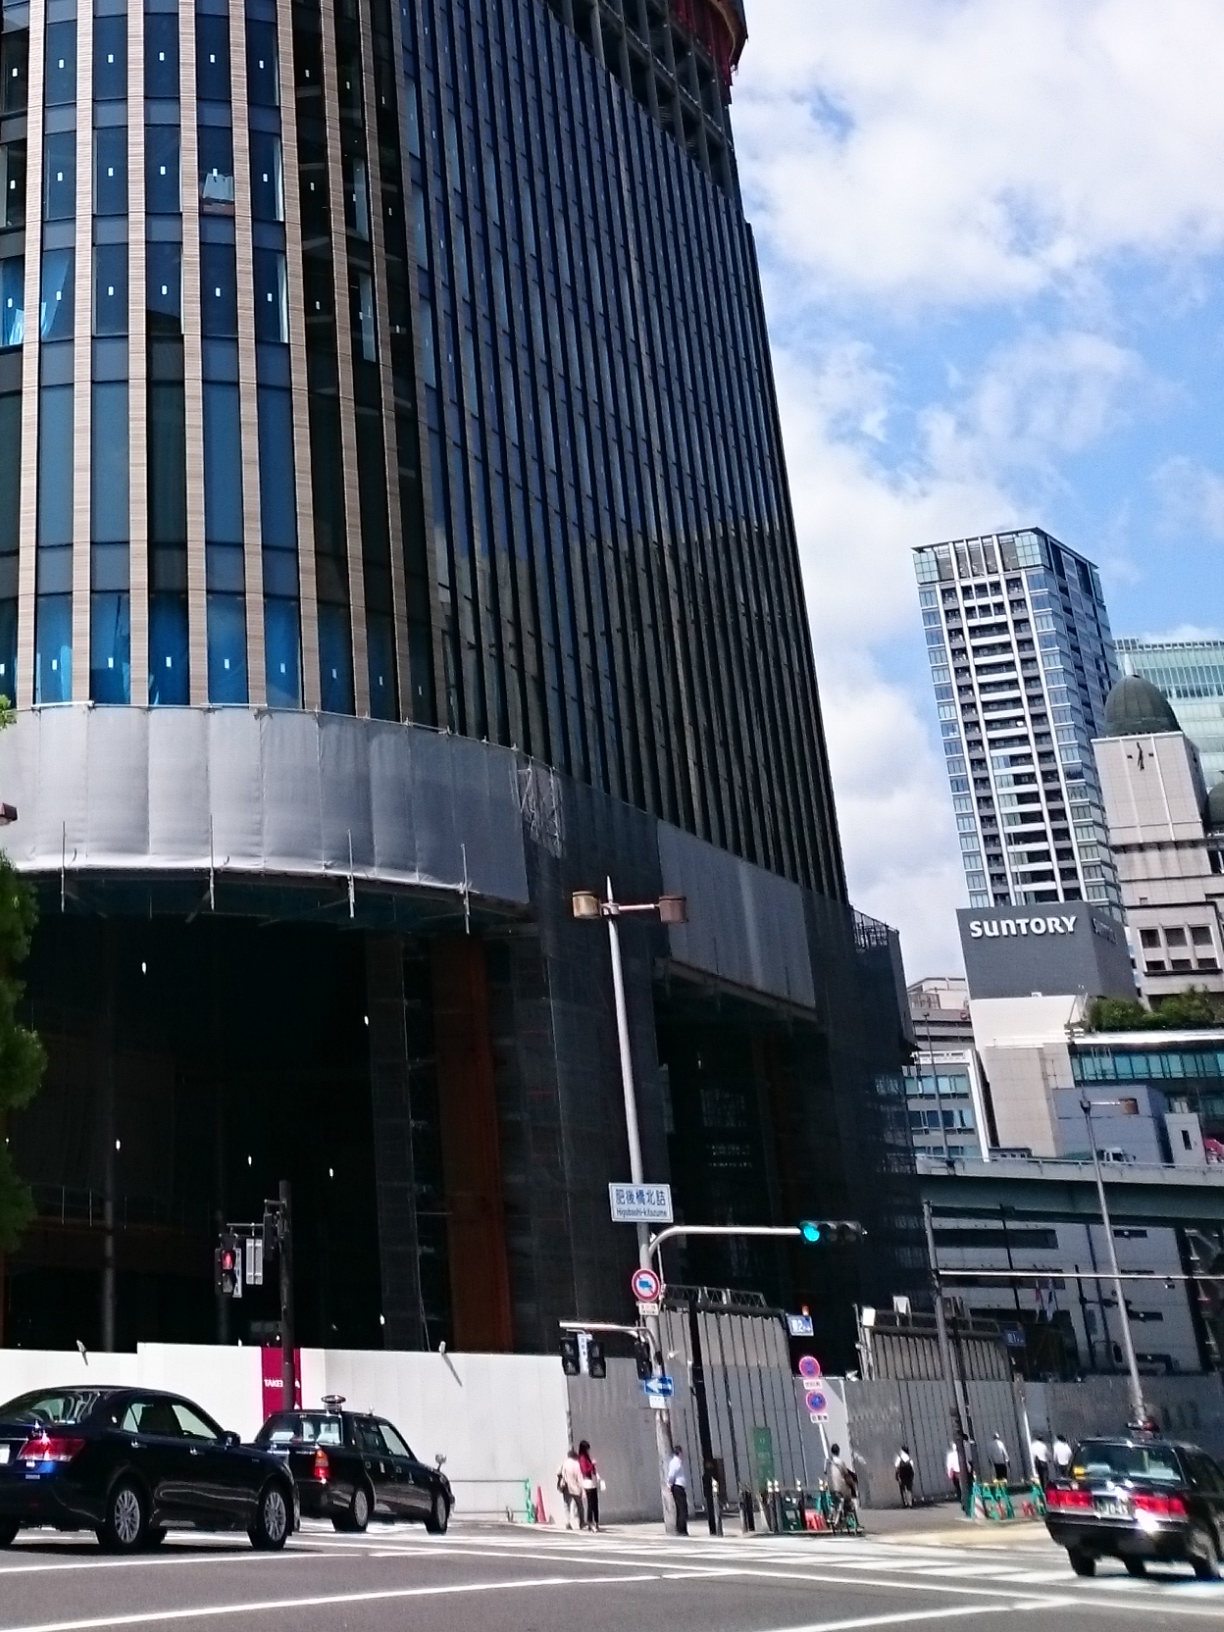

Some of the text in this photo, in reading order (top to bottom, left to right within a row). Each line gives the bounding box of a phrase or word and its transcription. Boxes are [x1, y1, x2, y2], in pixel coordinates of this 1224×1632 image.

[969, 915, 1077, 939] SUNTORY
[615, 1188, 666, 1206] 肥後橋北詰
